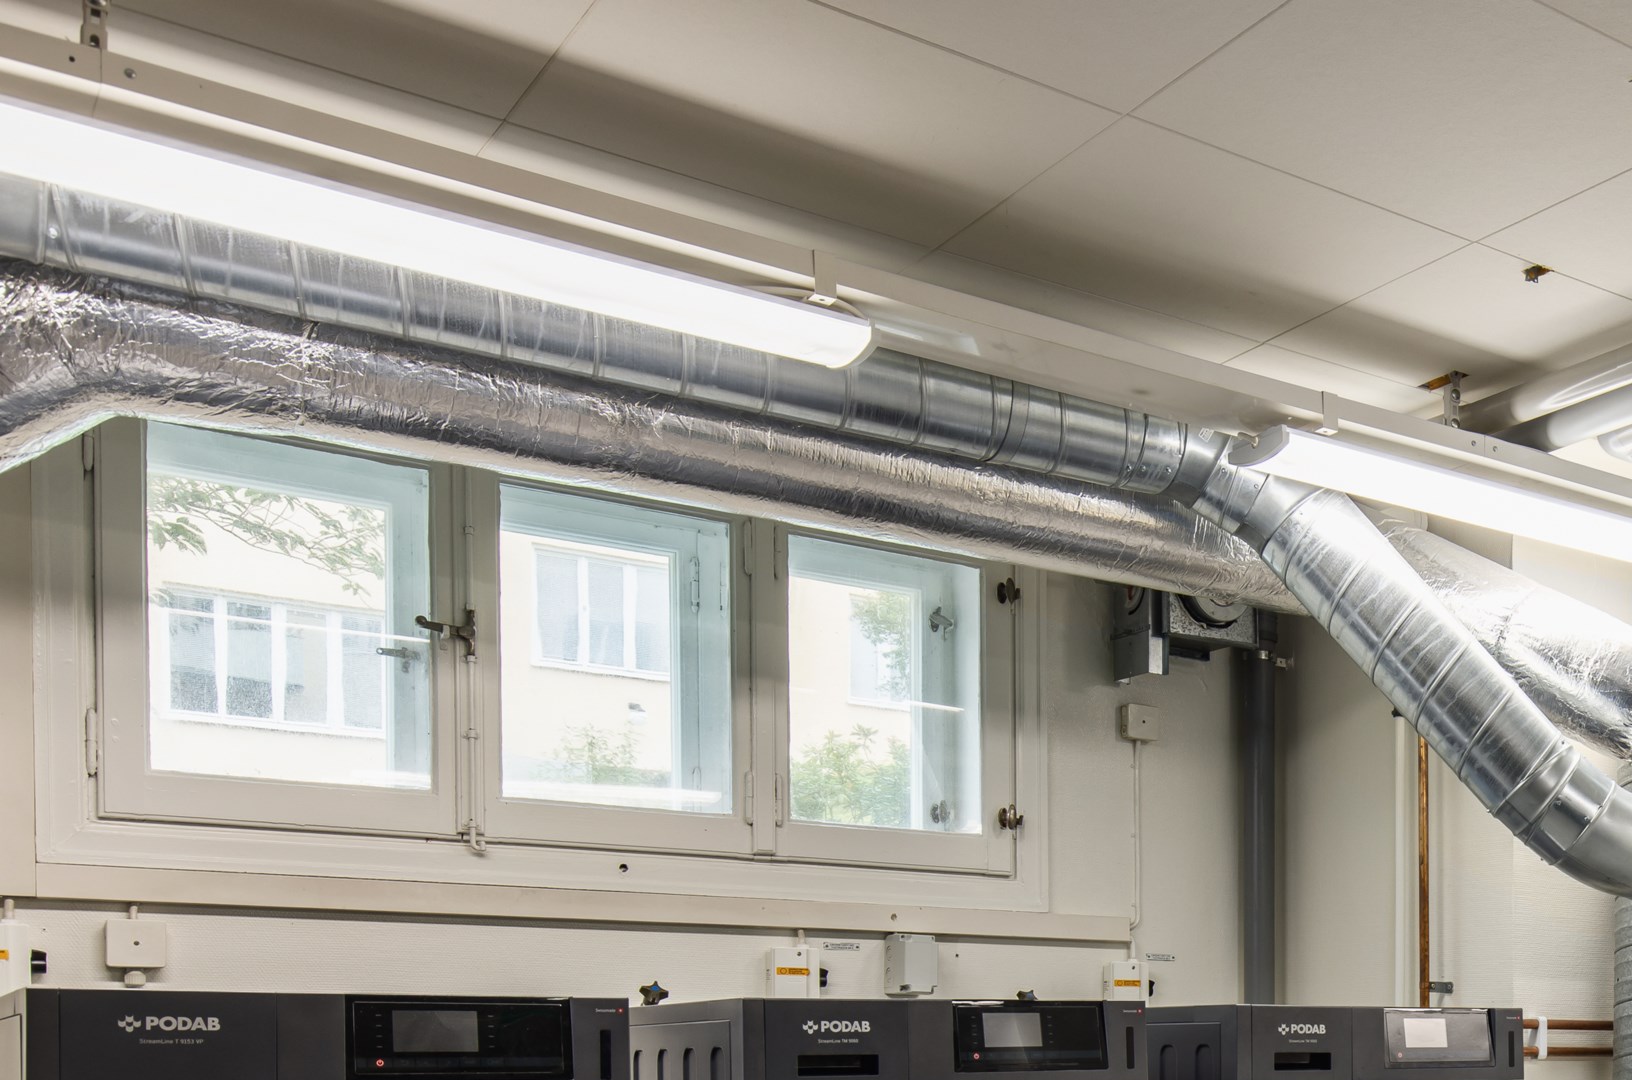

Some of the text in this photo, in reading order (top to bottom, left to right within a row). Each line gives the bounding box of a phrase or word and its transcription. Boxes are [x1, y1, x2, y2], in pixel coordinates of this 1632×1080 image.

[145, 1016, 220, 1031] PODAB
[820, 1020, 871, 1033] PODAB
[1290, 1023, 1326, 1034] PODAB
